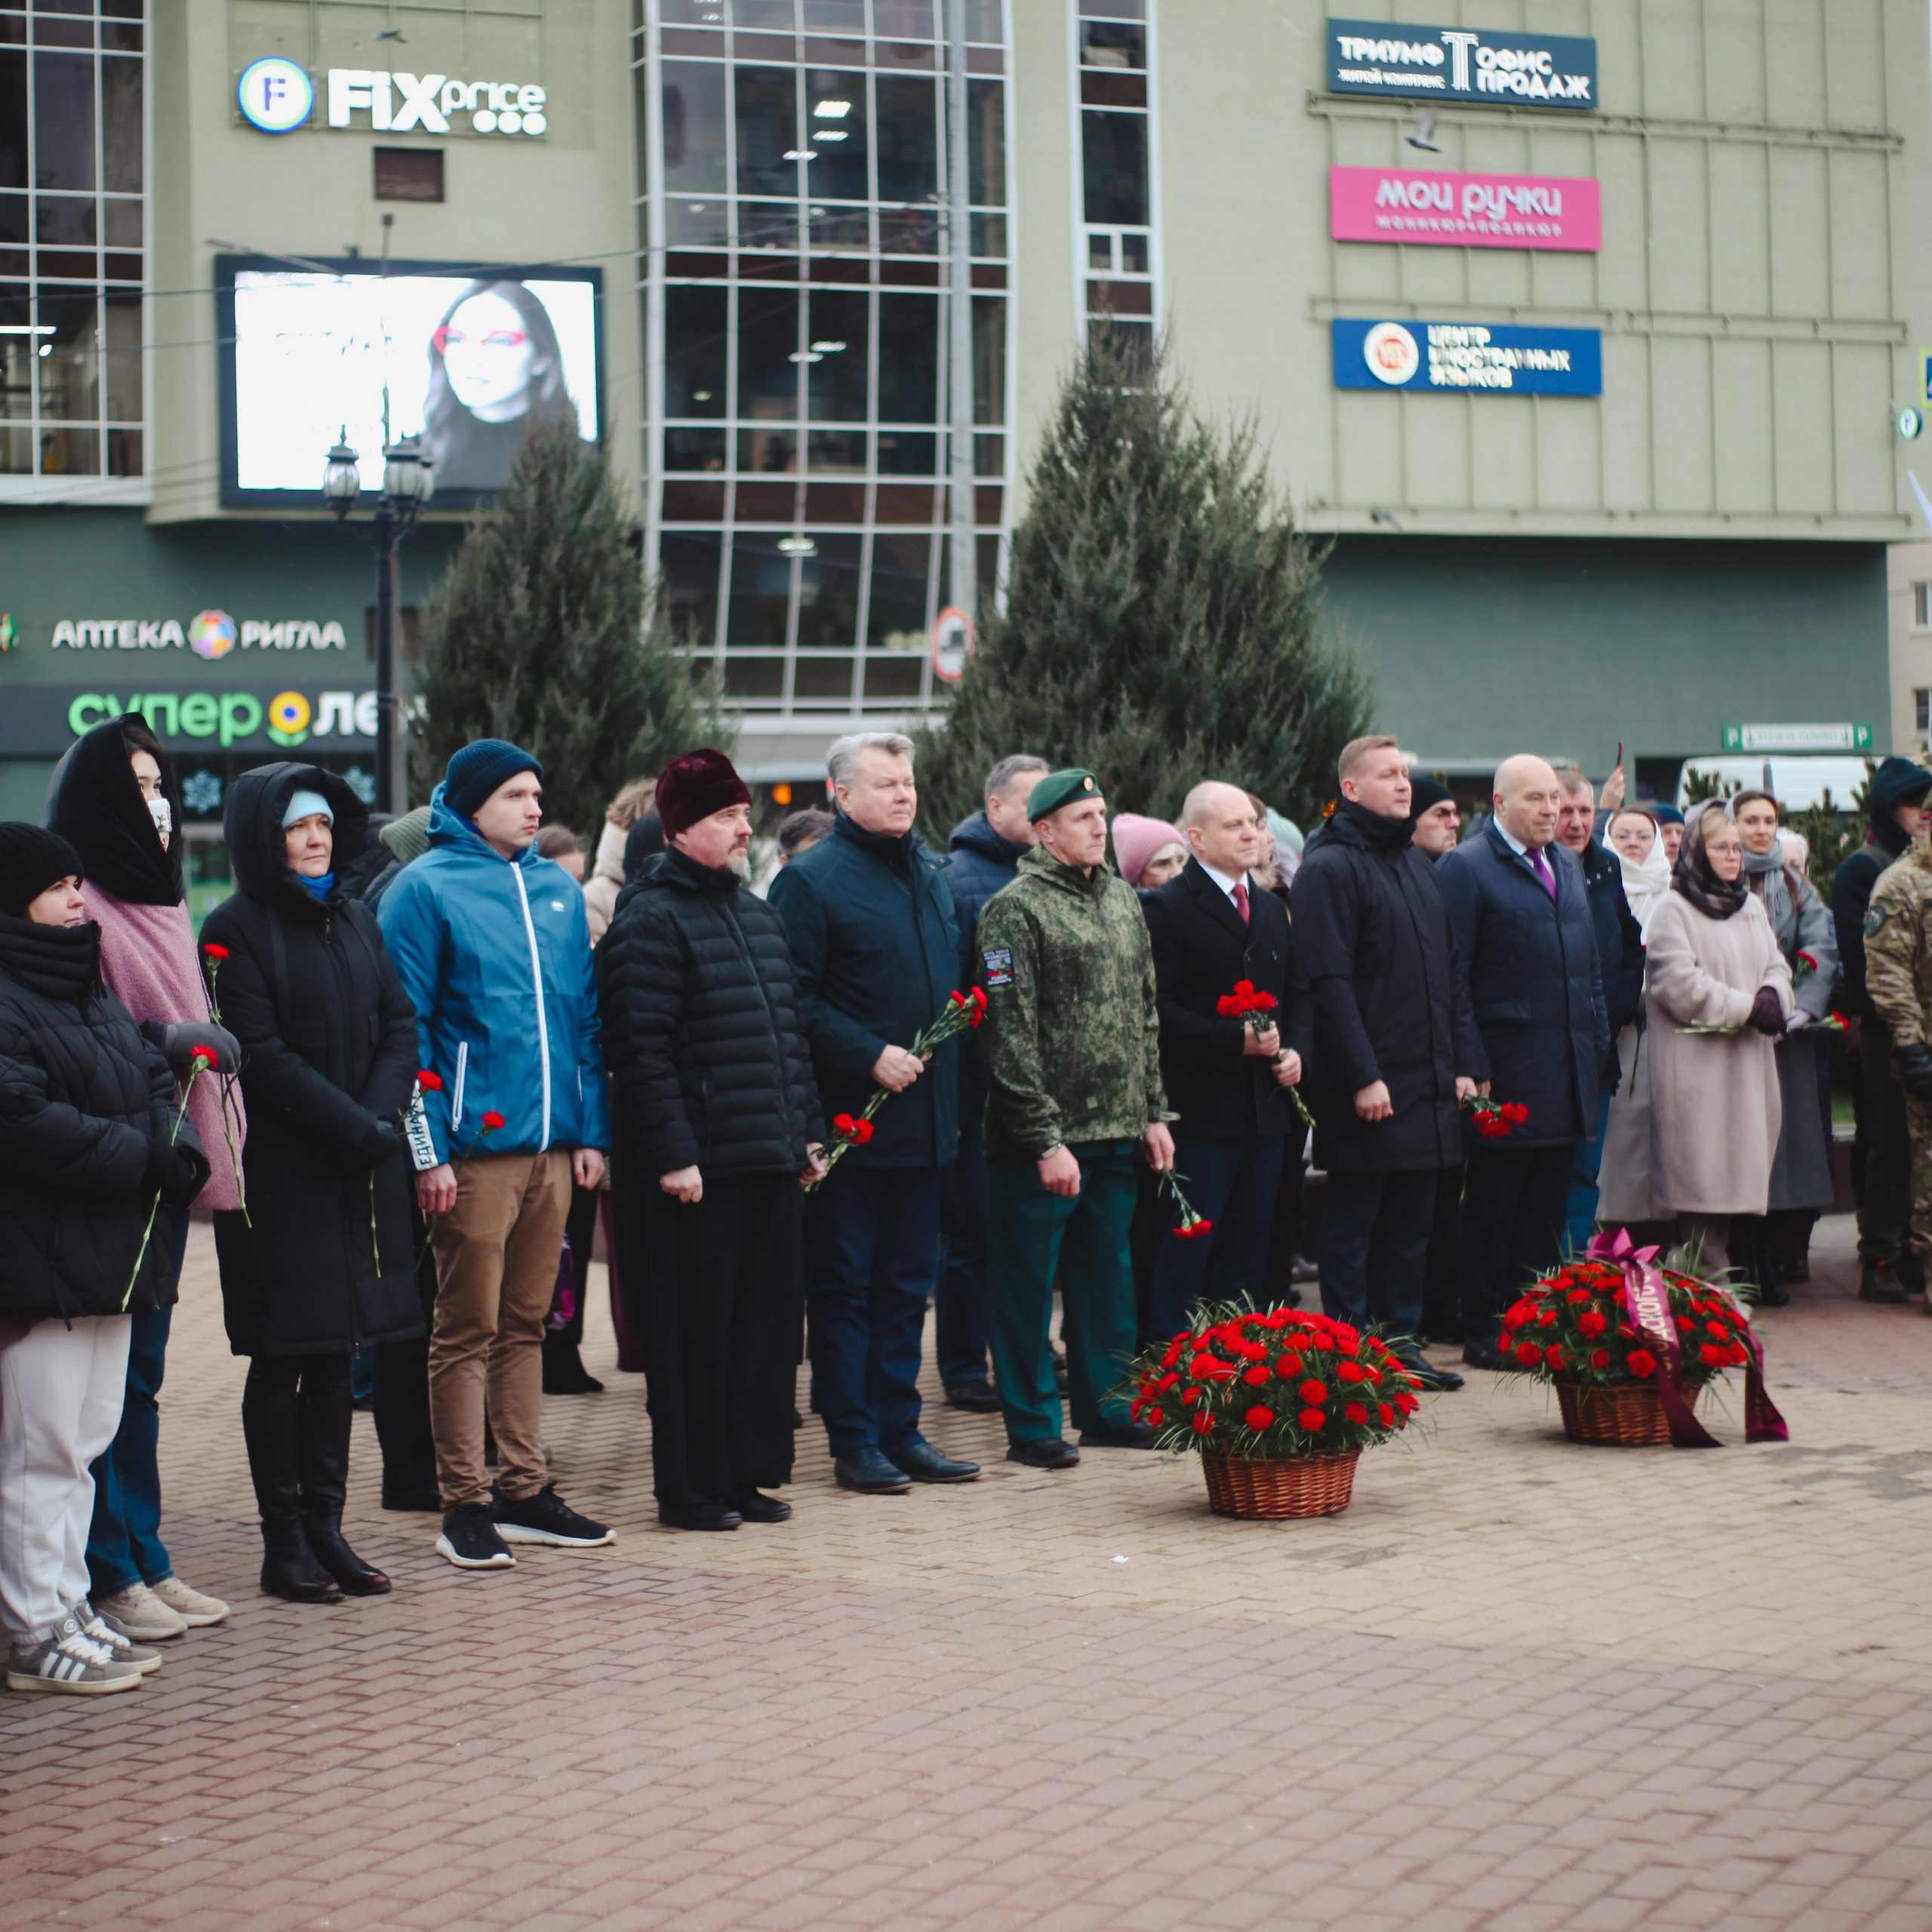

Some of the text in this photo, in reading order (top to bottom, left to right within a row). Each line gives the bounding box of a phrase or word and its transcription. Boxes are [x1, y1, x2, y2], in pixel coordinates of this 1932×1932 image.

[1337, 36, 1445, 66] ТРИУМФ
[1475, 46, 1552, 75] ОФИС
[441, 79, 547, 116] price
[1476, 69, 1592, 100] ПРОДАЖ
[1427, 325, 1491, 347] ЦЕНТР
[1427, 345, 1571, 371] ИНОСТРАННЫХ
[1429, 364, 1513, 388] ЯЗЫКОВ
[51, 620, 346, 650] АПТЕКА РИГЛА
